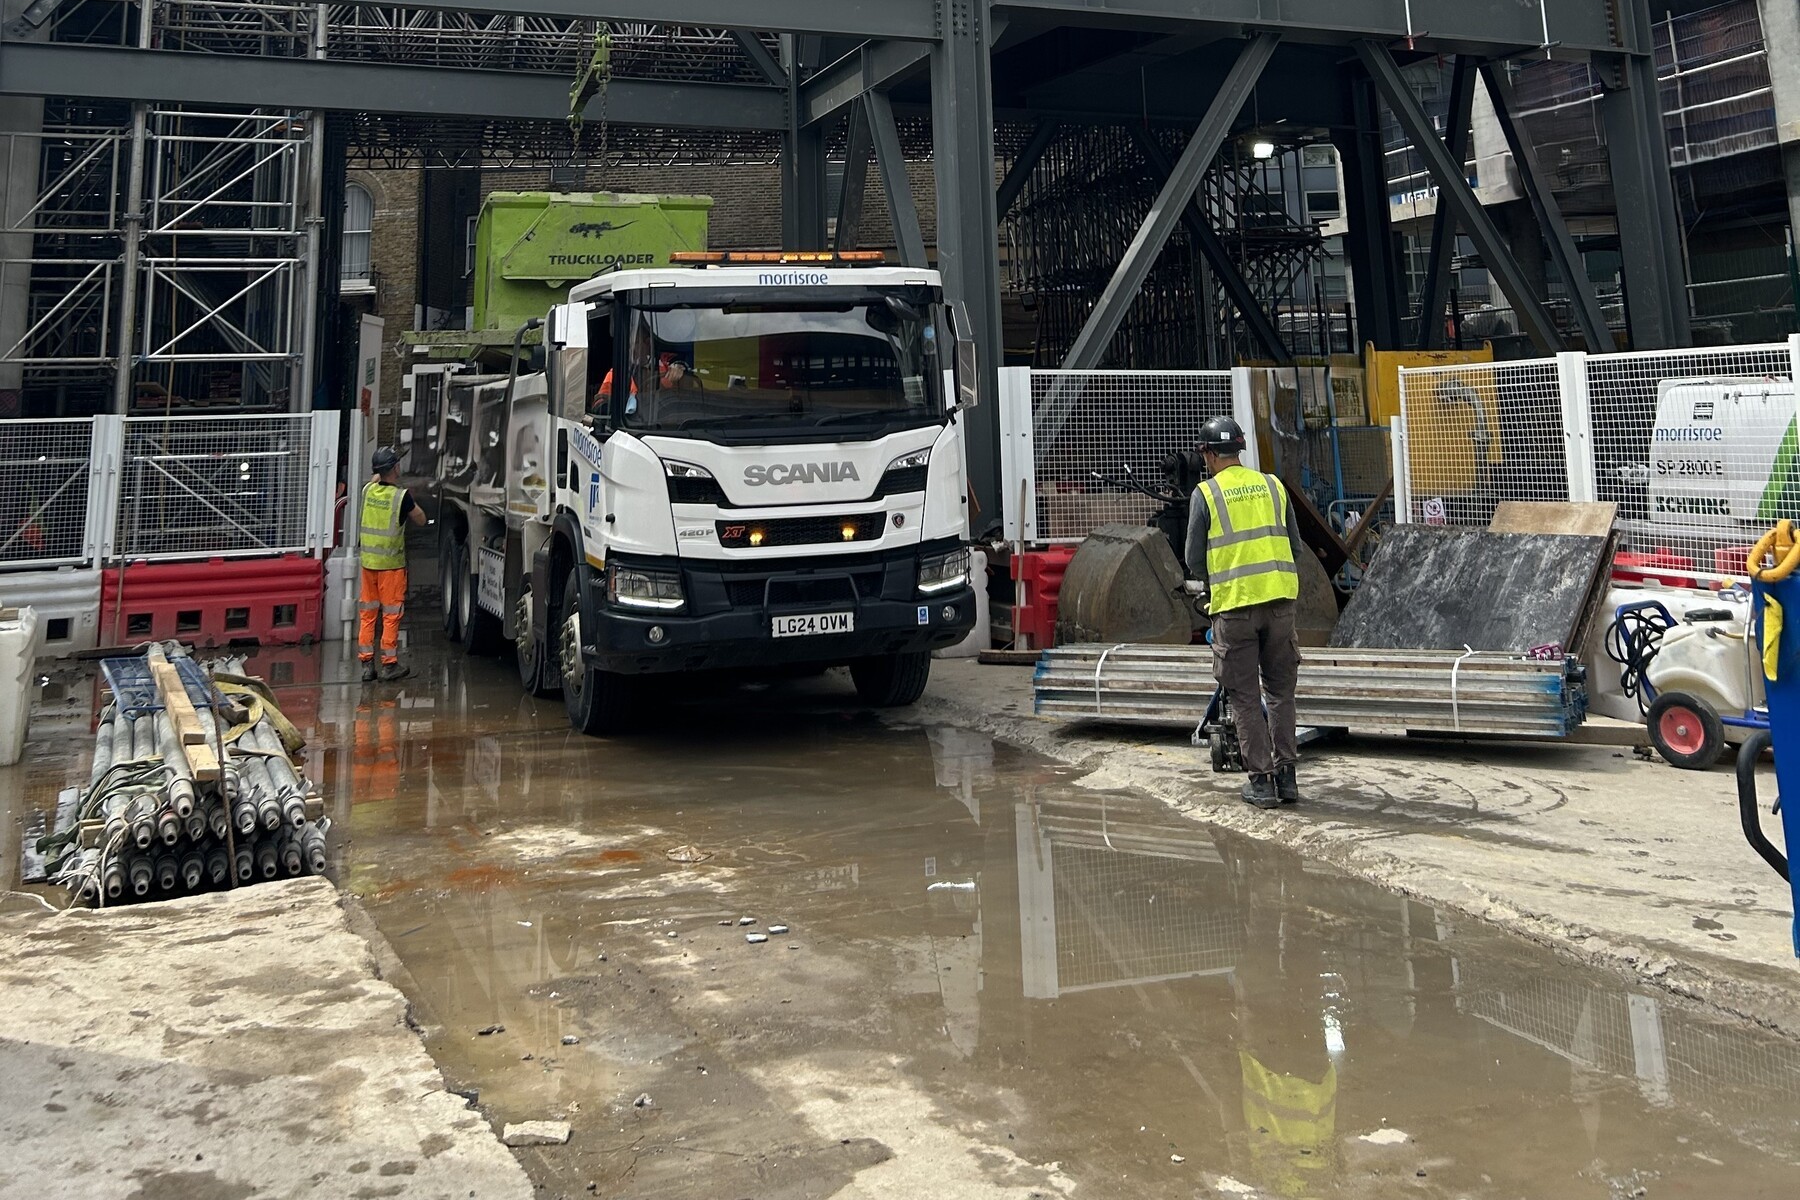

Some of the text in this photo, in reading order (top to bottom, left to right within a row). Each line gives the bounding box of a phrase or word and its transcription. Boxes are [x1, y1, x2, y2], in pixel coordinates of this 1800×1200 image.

[548, 254, 654, 265] TRUCKLOADER
[759, 271, 828, 285] morrisroe
[1656, 424, 1722, 441] morrisroe
[573, 427, 602, 468] morrisroe
[743, 461, 861, 487] SCANIA
[1656, 460, 1723, 475] SP 2800 E
[1223, 483, 1267, 498] morrisroe
[722, 526, 745, 539] XT
[778, 615, 848, 634] LG24 OVM
